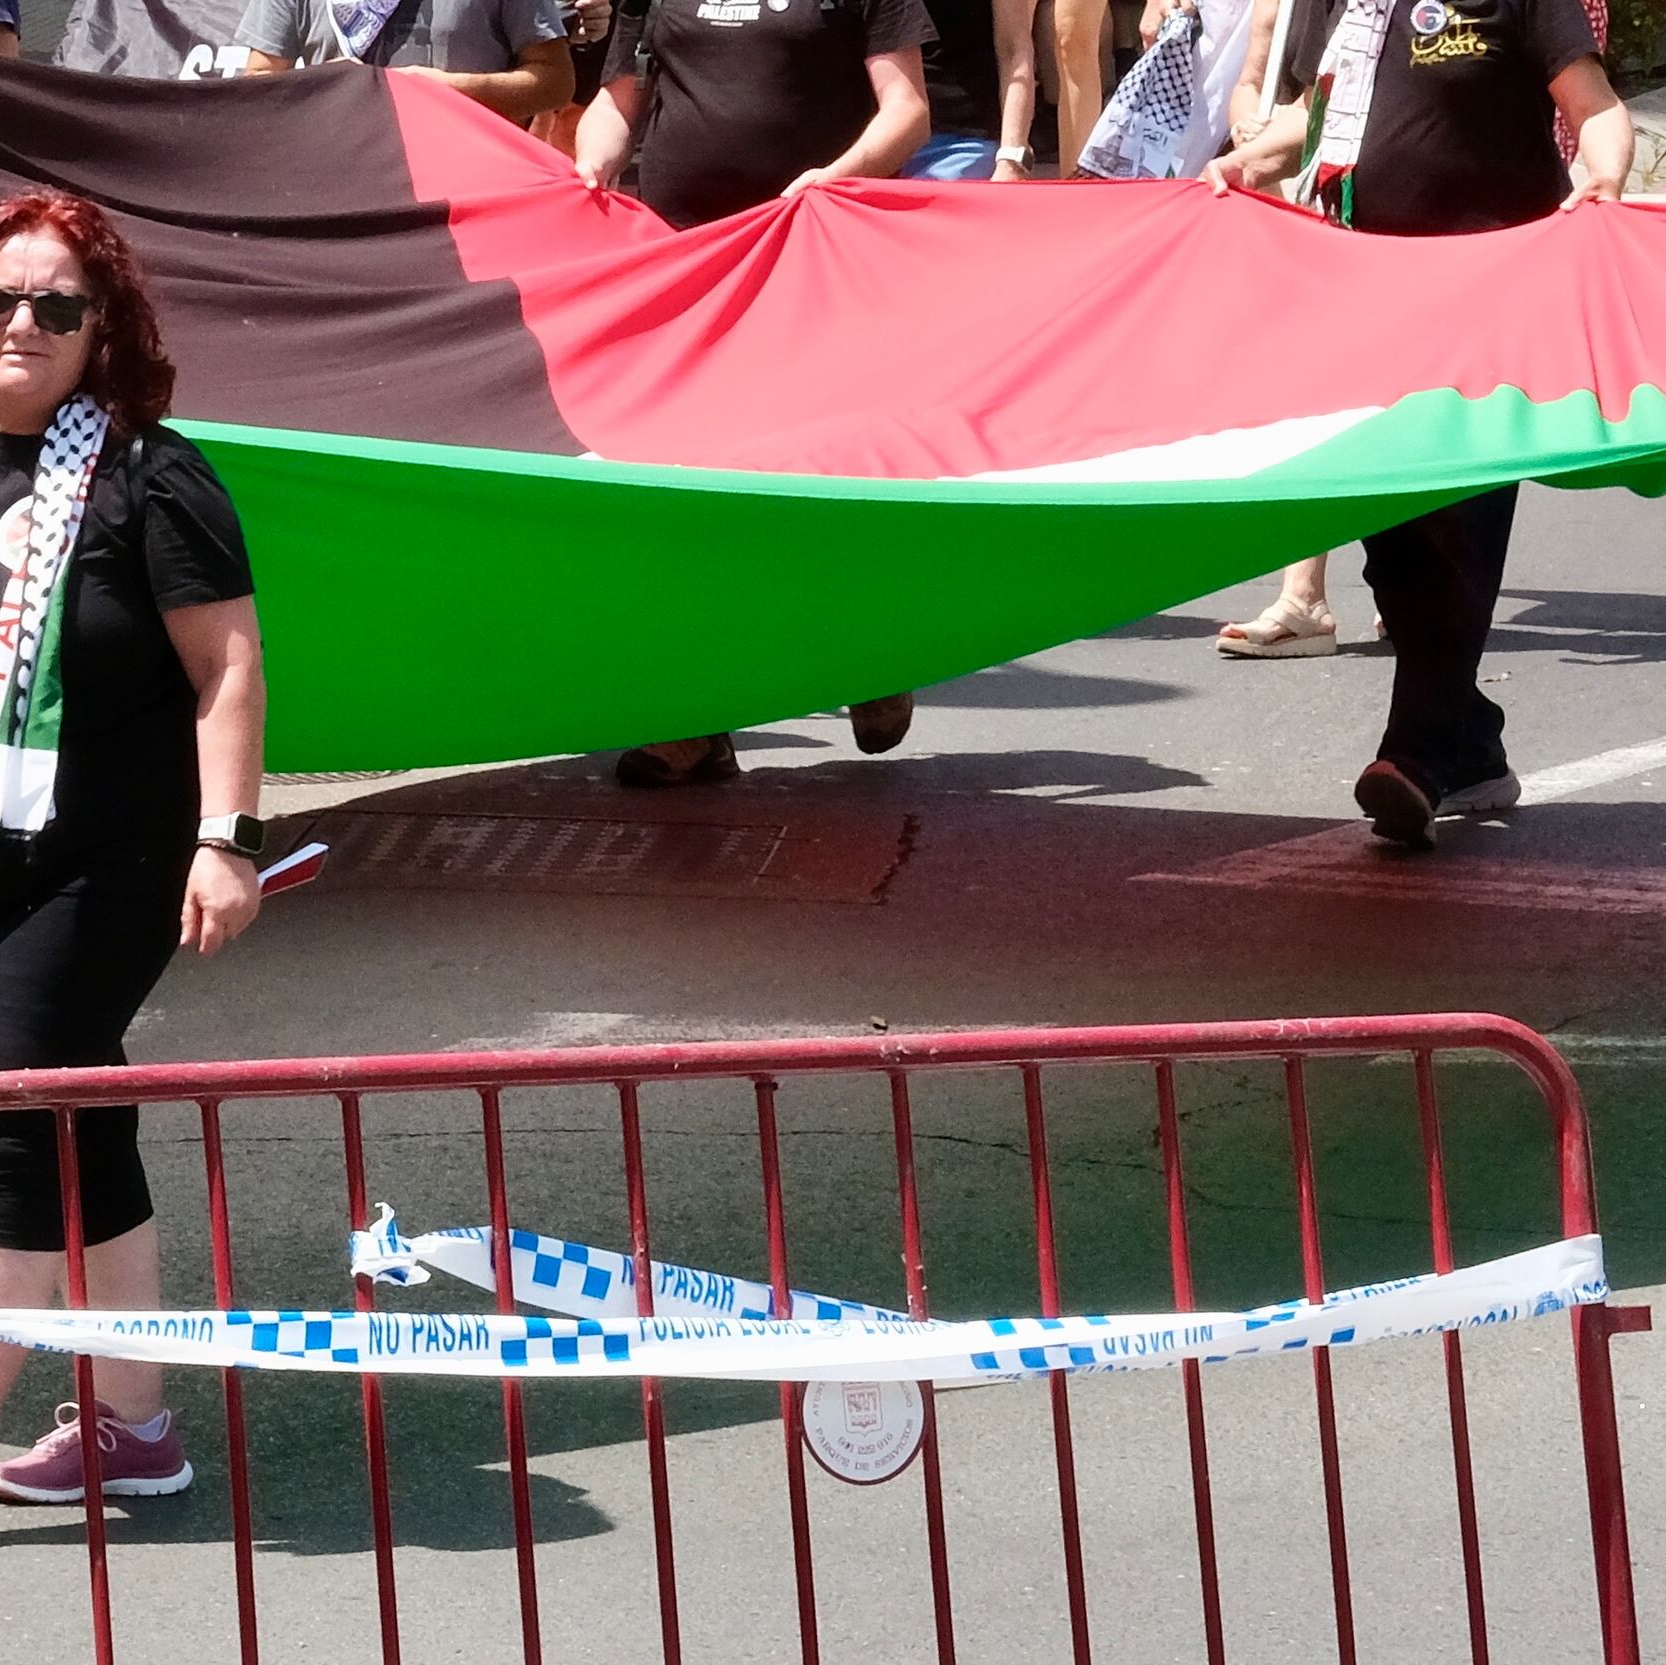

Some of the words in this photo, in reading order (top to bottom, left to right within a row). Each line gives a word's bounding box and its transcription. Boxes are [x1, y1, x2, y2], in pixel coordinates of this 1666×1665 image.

[696, 3, 761, 21] PALESTINE
[661, 1263, 735, 1313] PASAR
[411, 1312, 490, 1354] PASAR
[815, 1427, 851, 1468] PARQUE
[854, 1459, 870, 1472] DE
